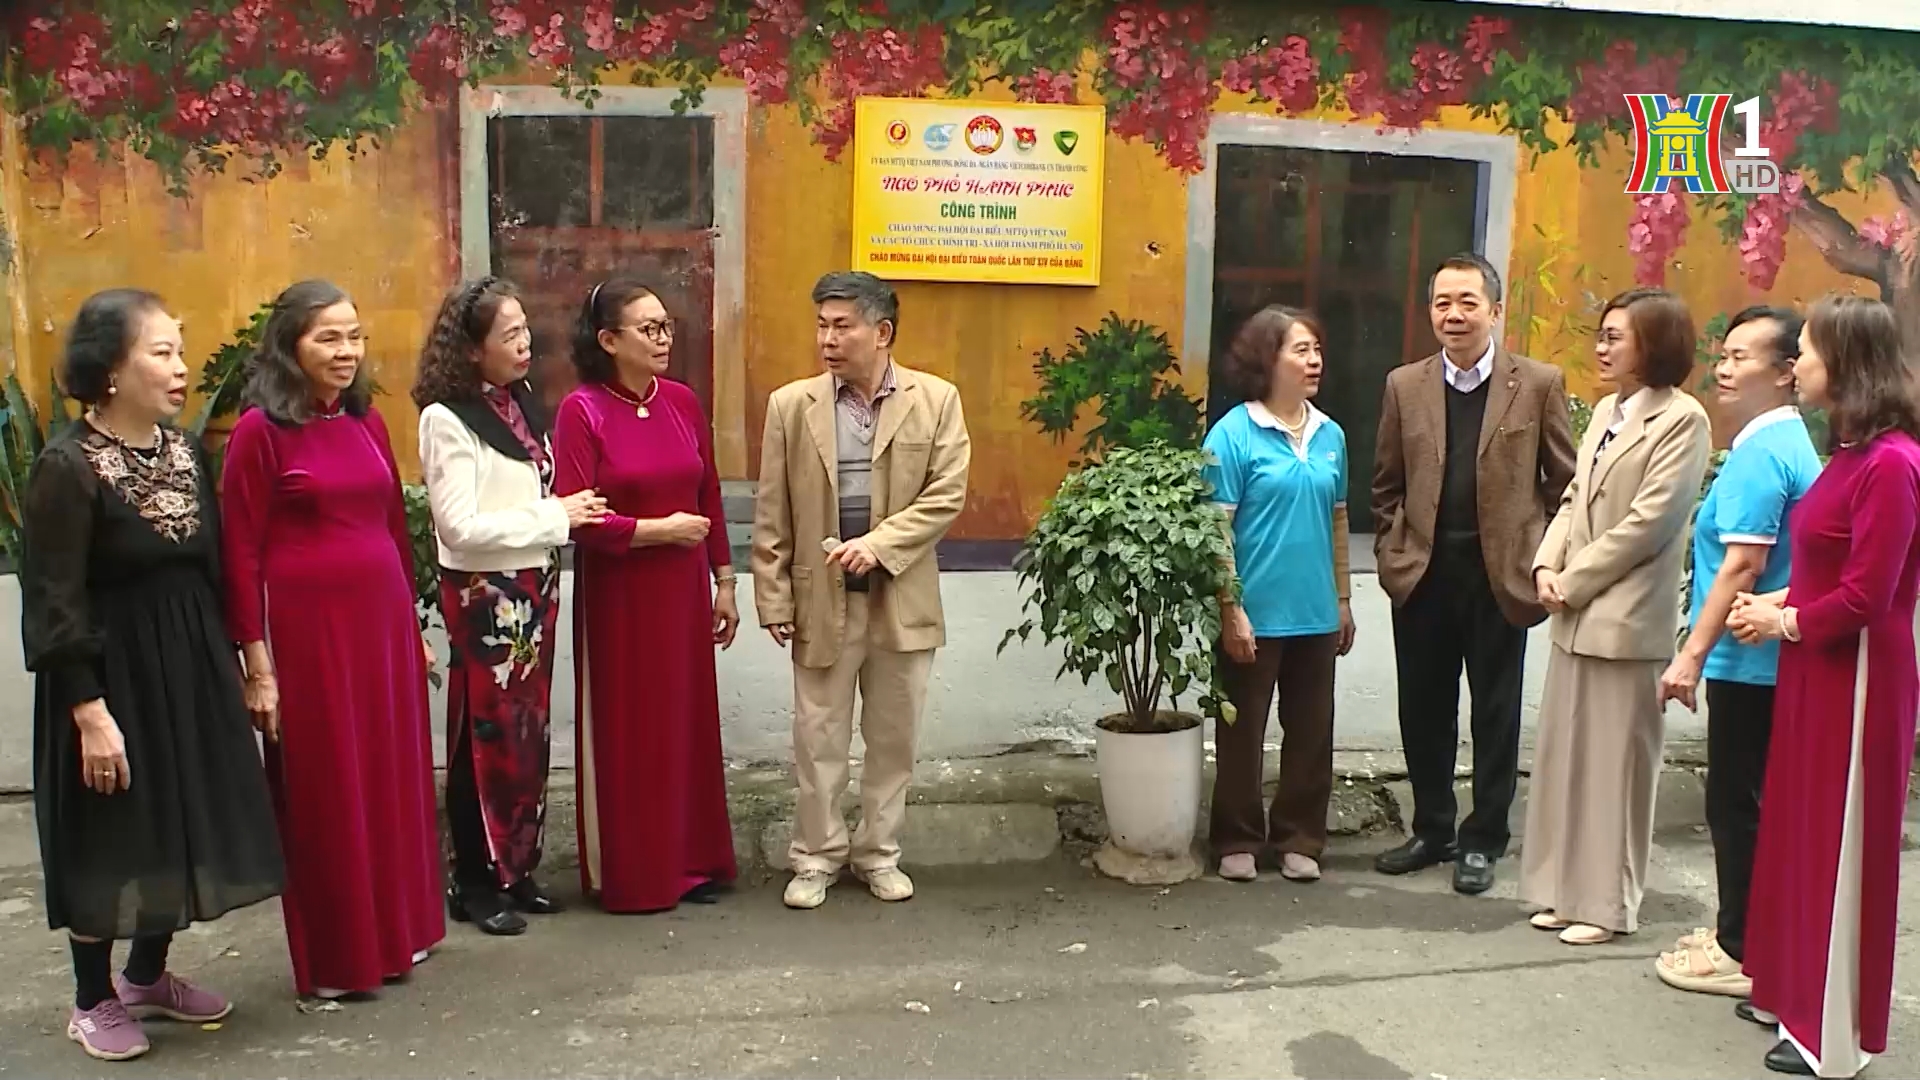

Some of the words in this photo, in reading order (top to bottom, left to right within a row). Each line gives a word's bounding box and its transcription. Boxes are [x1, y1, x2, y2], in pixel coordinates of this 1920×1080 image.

[941, 201, 975, 218] CÔNG
[979, 202, 1017, 220] TRÌNH
[1049, 229, 1067, 237] NAM
